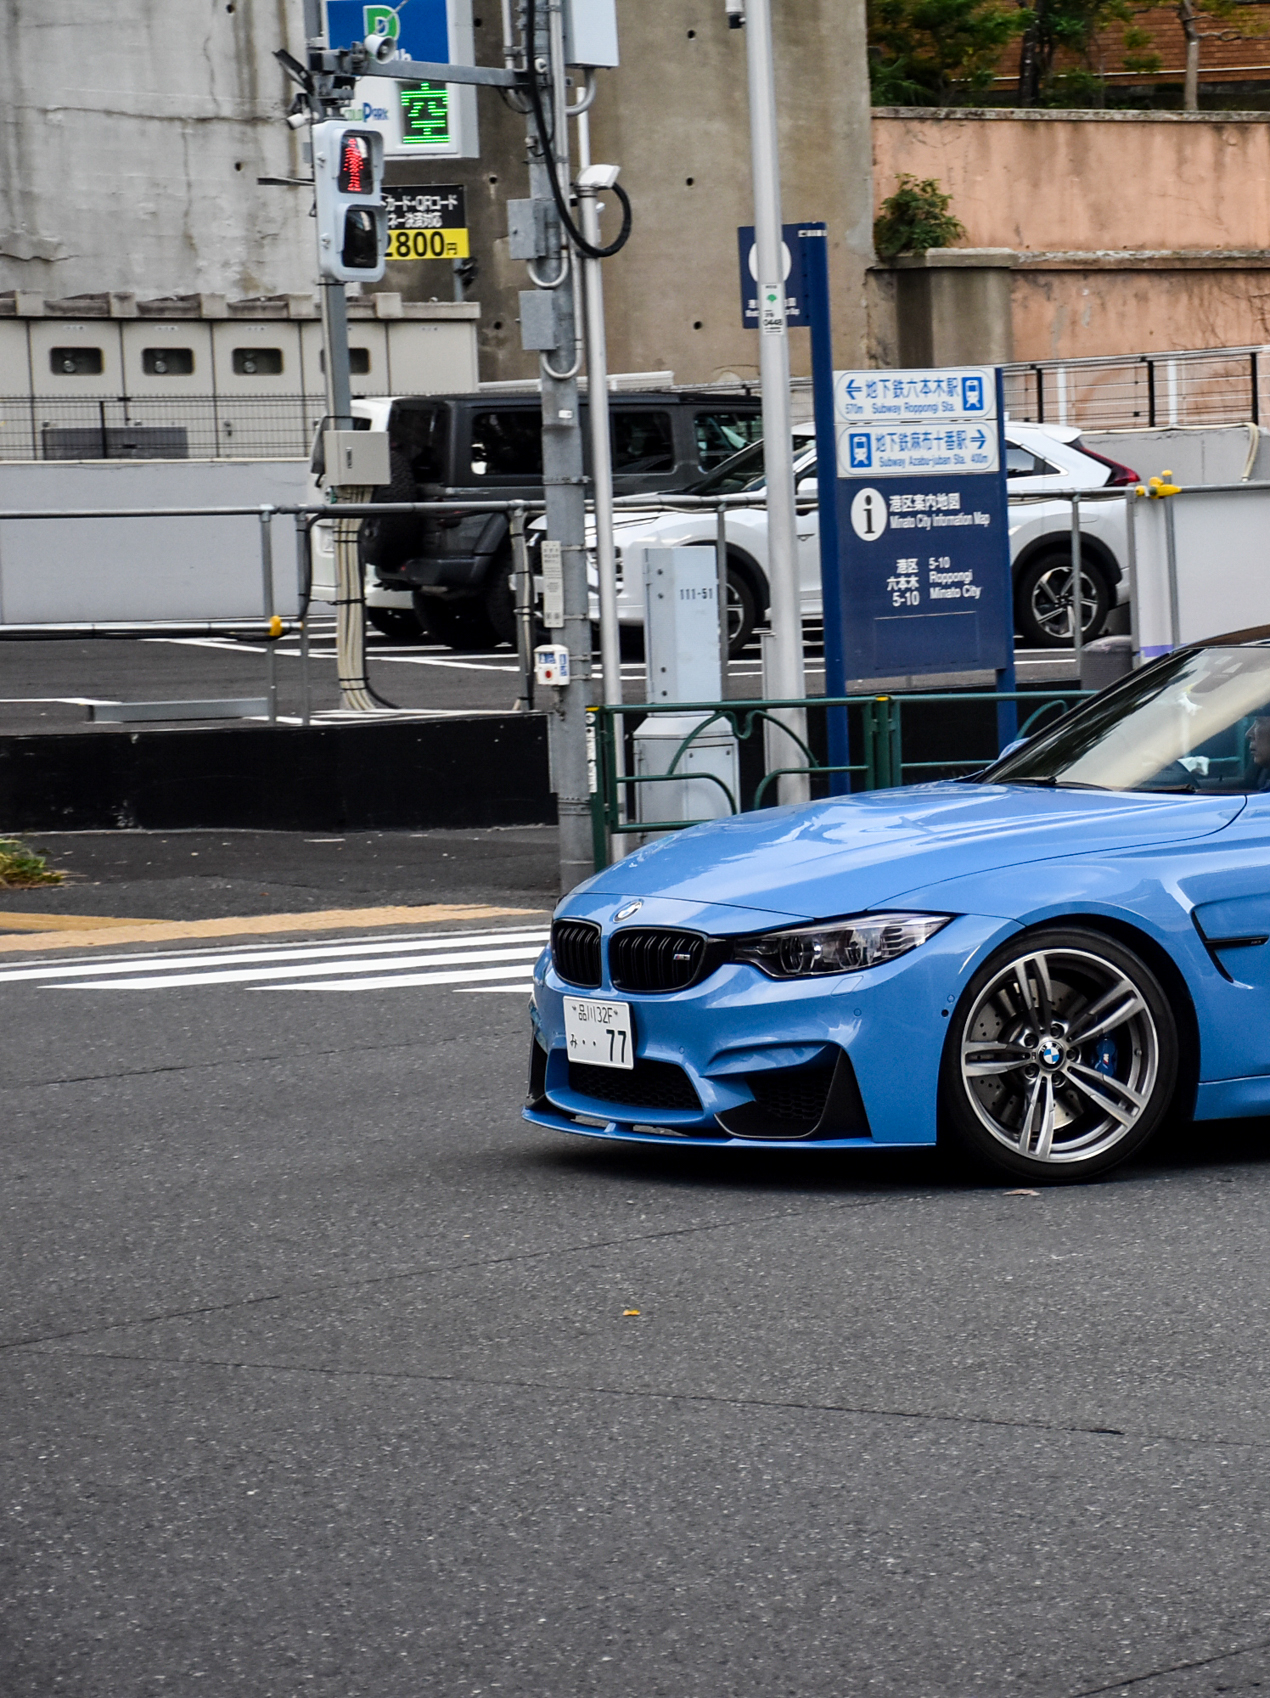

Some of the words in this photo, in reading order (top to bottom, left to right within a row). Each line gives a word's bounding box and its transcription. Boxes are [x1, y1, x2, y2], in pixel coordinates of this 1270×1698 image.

[401, 82, 451, 144] 空
[865, 377, 960, 398] 地下鉄六本木駅
[872, 403, 901, 415] Subway
[904, 401, 939, 414] Roppongi
[875, 430, 968, 452] 地下鉄麻布十番駅
[879, 456, 906, 468] Subway
[889, 492, 960, 512] 港区案内地図
[889, 515, 915, 529] Minato
[916, 514, 932, 531] City
[932, 512, 973, 527] Information
[973, 511, 990, 527] Map
[896, 558, 919, 573] 港区
[928, 556, 951, 569] 5-10
[886, 575, 919, 590] 六本木
[928, 569, 973, 585] Roppongi
[680, 588, 713, 600] 111-51
[892, 591, 920, 607] 5-10
[929, 587, 961, 599] Minato
[962, 585, 982, 600] City
[606, 1029, 627, 1063] 77
